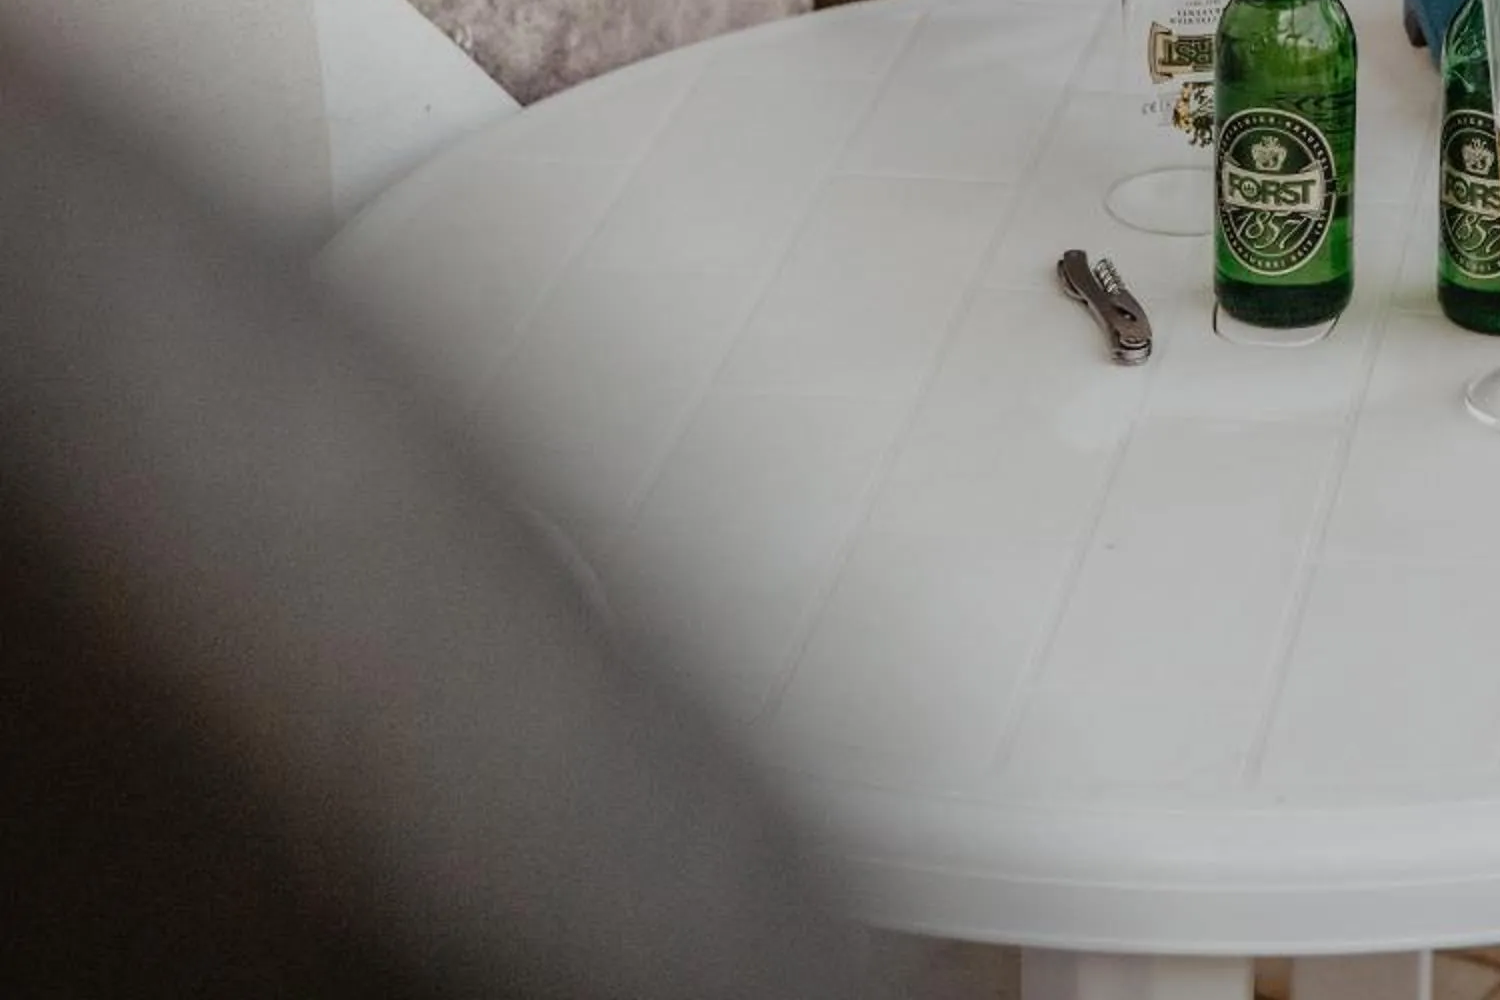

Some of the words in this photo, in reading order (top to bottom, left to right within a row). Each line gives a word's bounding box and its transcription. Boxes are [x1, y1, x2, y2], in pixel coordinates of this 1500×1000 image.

[1158, 38, 1214, 66] RST
[1228, 172, 1317, 206] FORST
[1237, 211, 1308, 249] 1857
